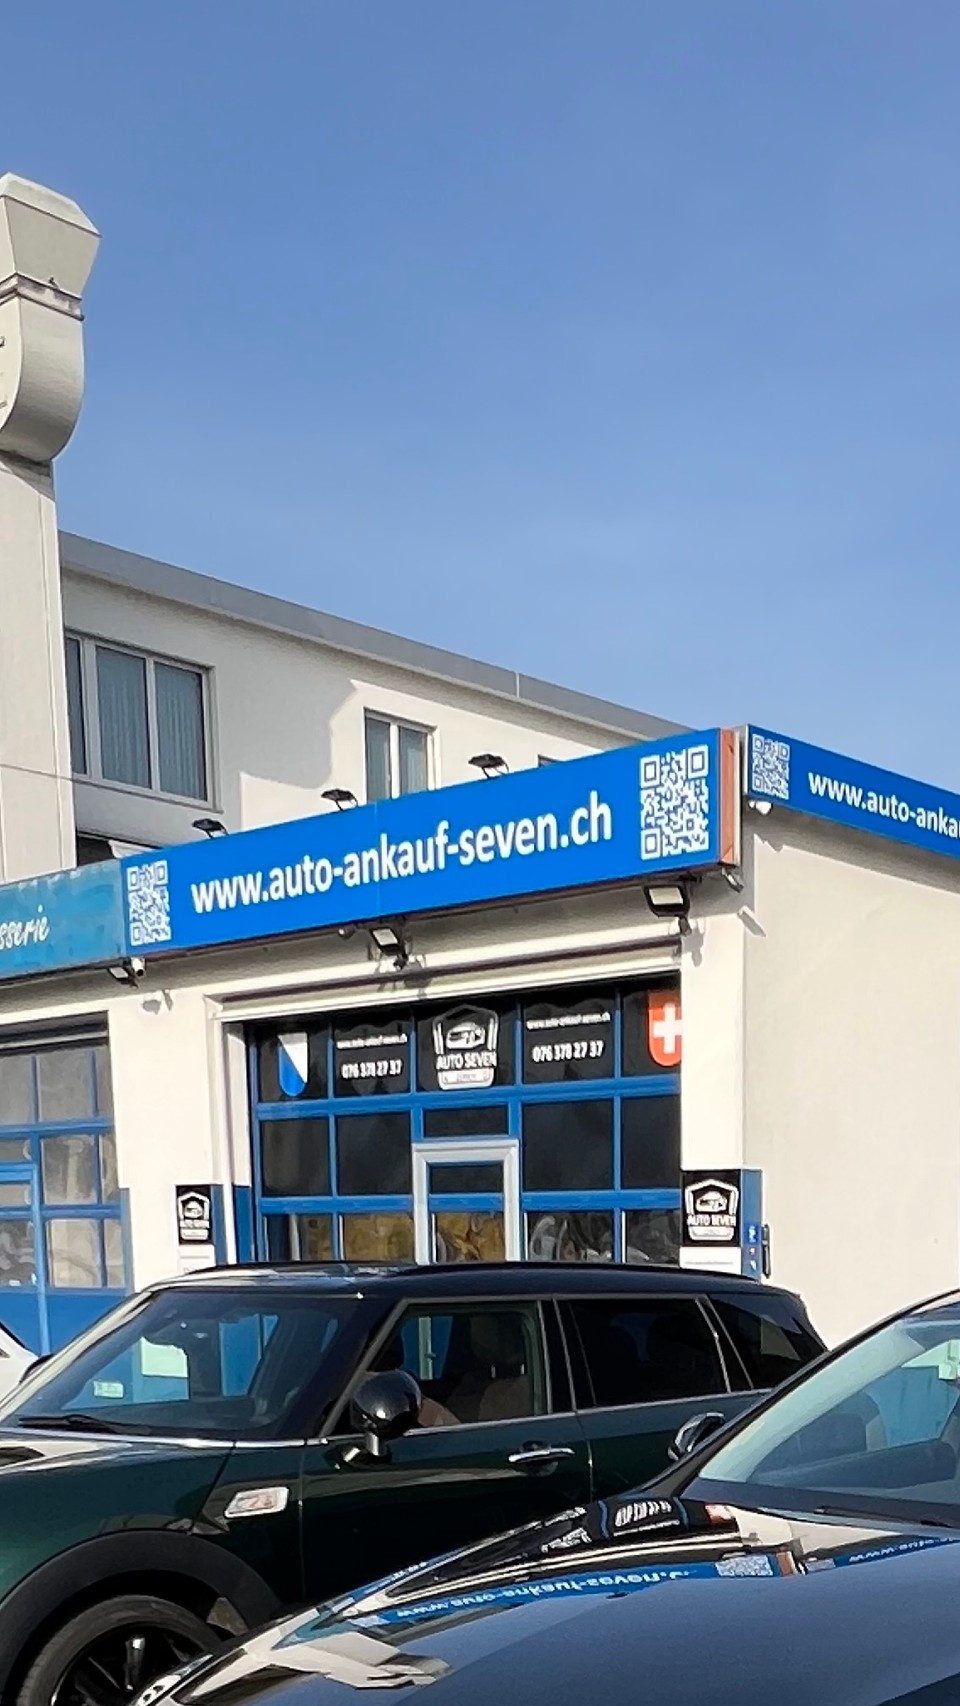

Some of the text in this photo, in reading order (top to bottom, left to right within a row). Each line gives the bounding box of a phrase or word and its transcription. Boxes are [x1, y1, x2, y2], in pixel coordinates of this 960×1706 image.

[191, 792, 612, 914] www.auto-ankauf-seven.ch
[436, 1050, 497, 1070] AUTO SEVEN
[532, 1040, 604, 1063] 076 378 27 37
